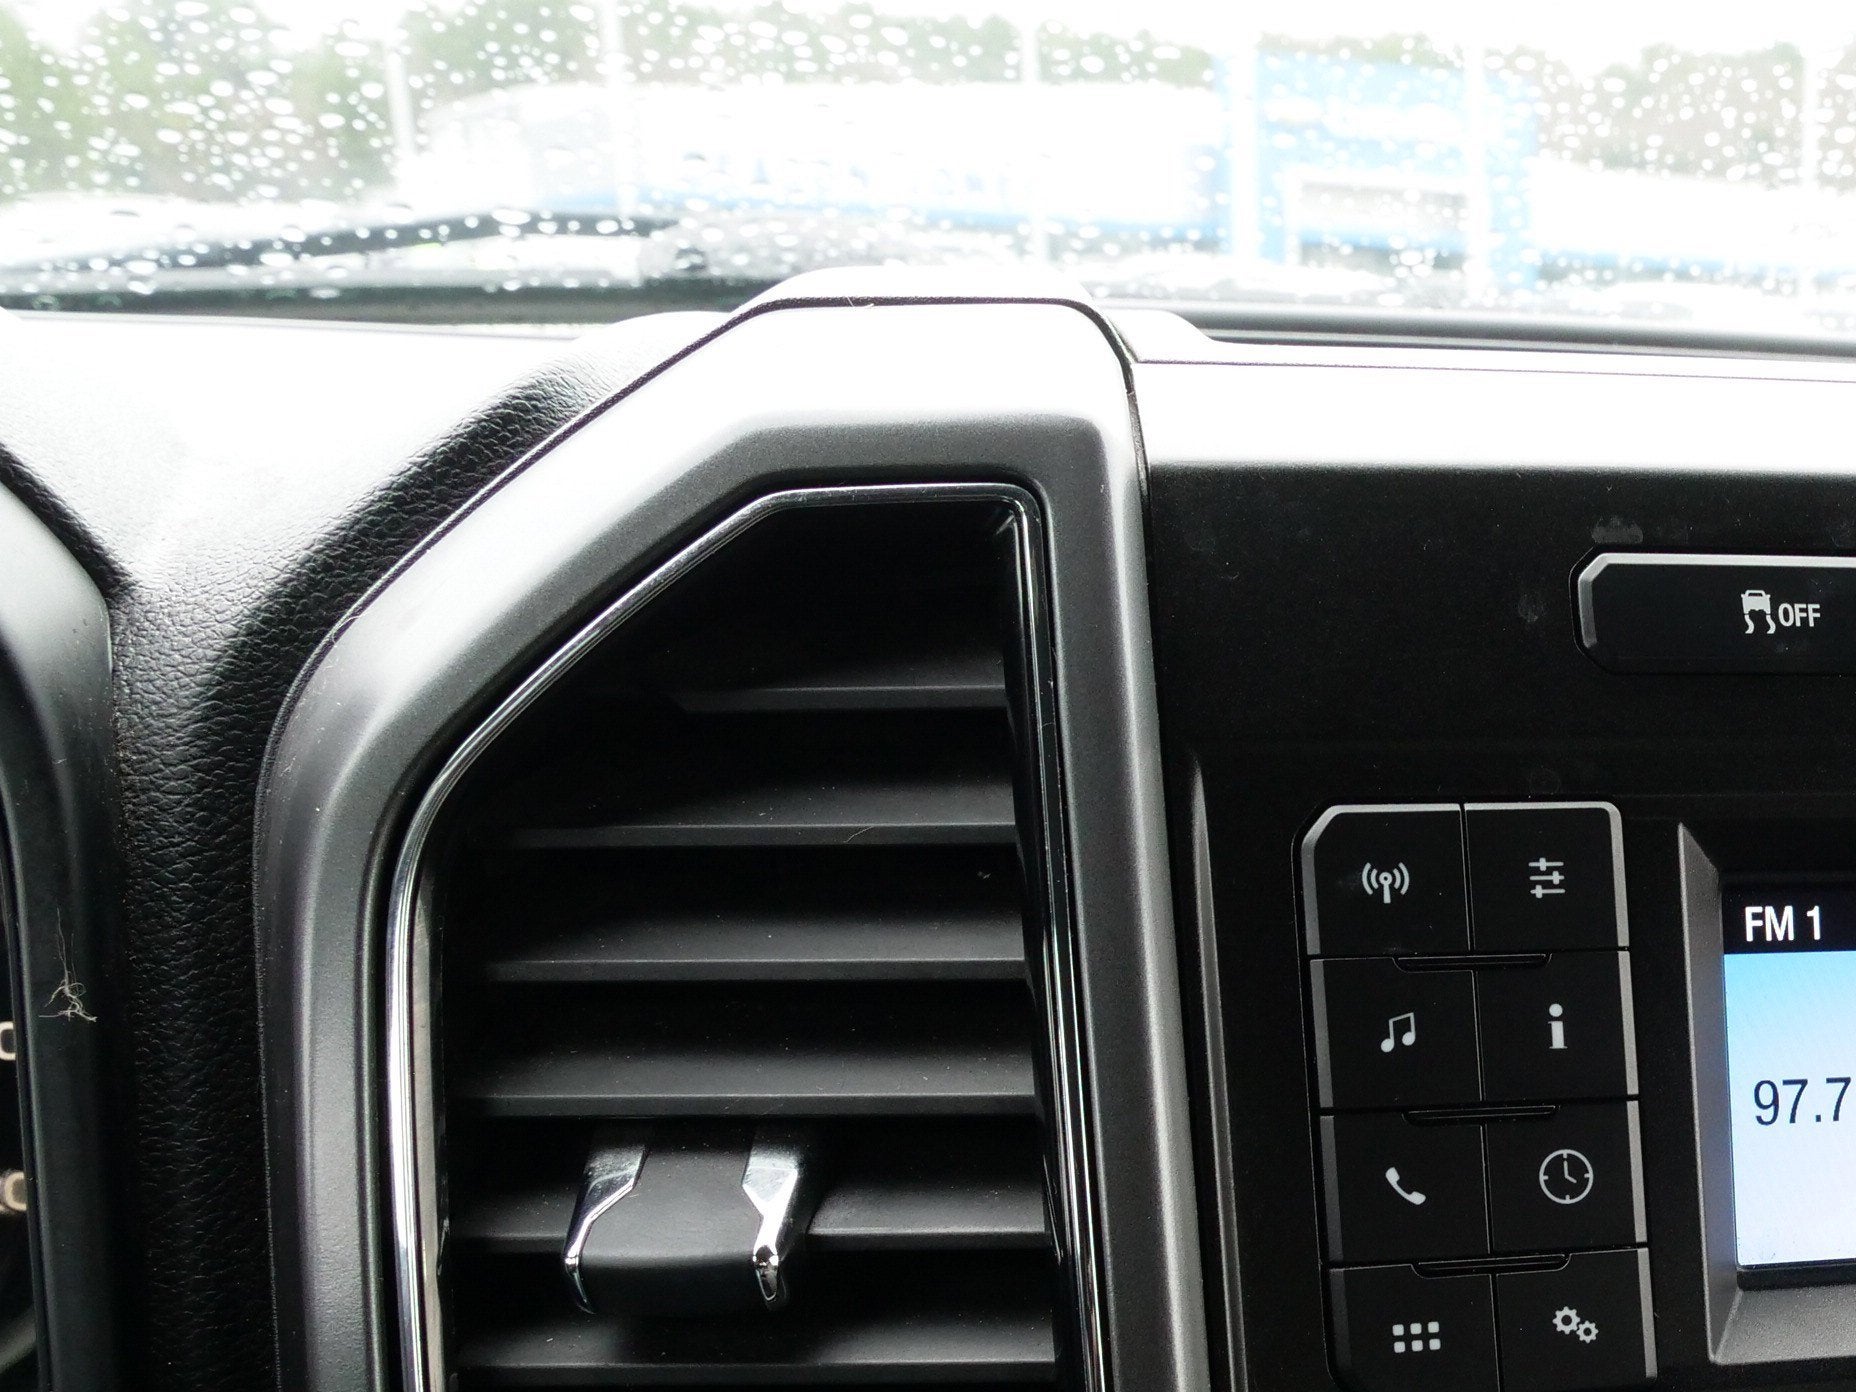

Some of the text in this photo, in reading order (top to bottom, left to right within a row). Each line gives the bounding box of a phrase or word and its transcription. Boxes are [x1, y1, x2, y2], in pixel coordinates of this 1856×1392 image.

[1778, 602, 1821, 628] OFF
[1744, 905, 1821, 942] FM 1
[1753, 1076, 1852, 1126] 97.7
